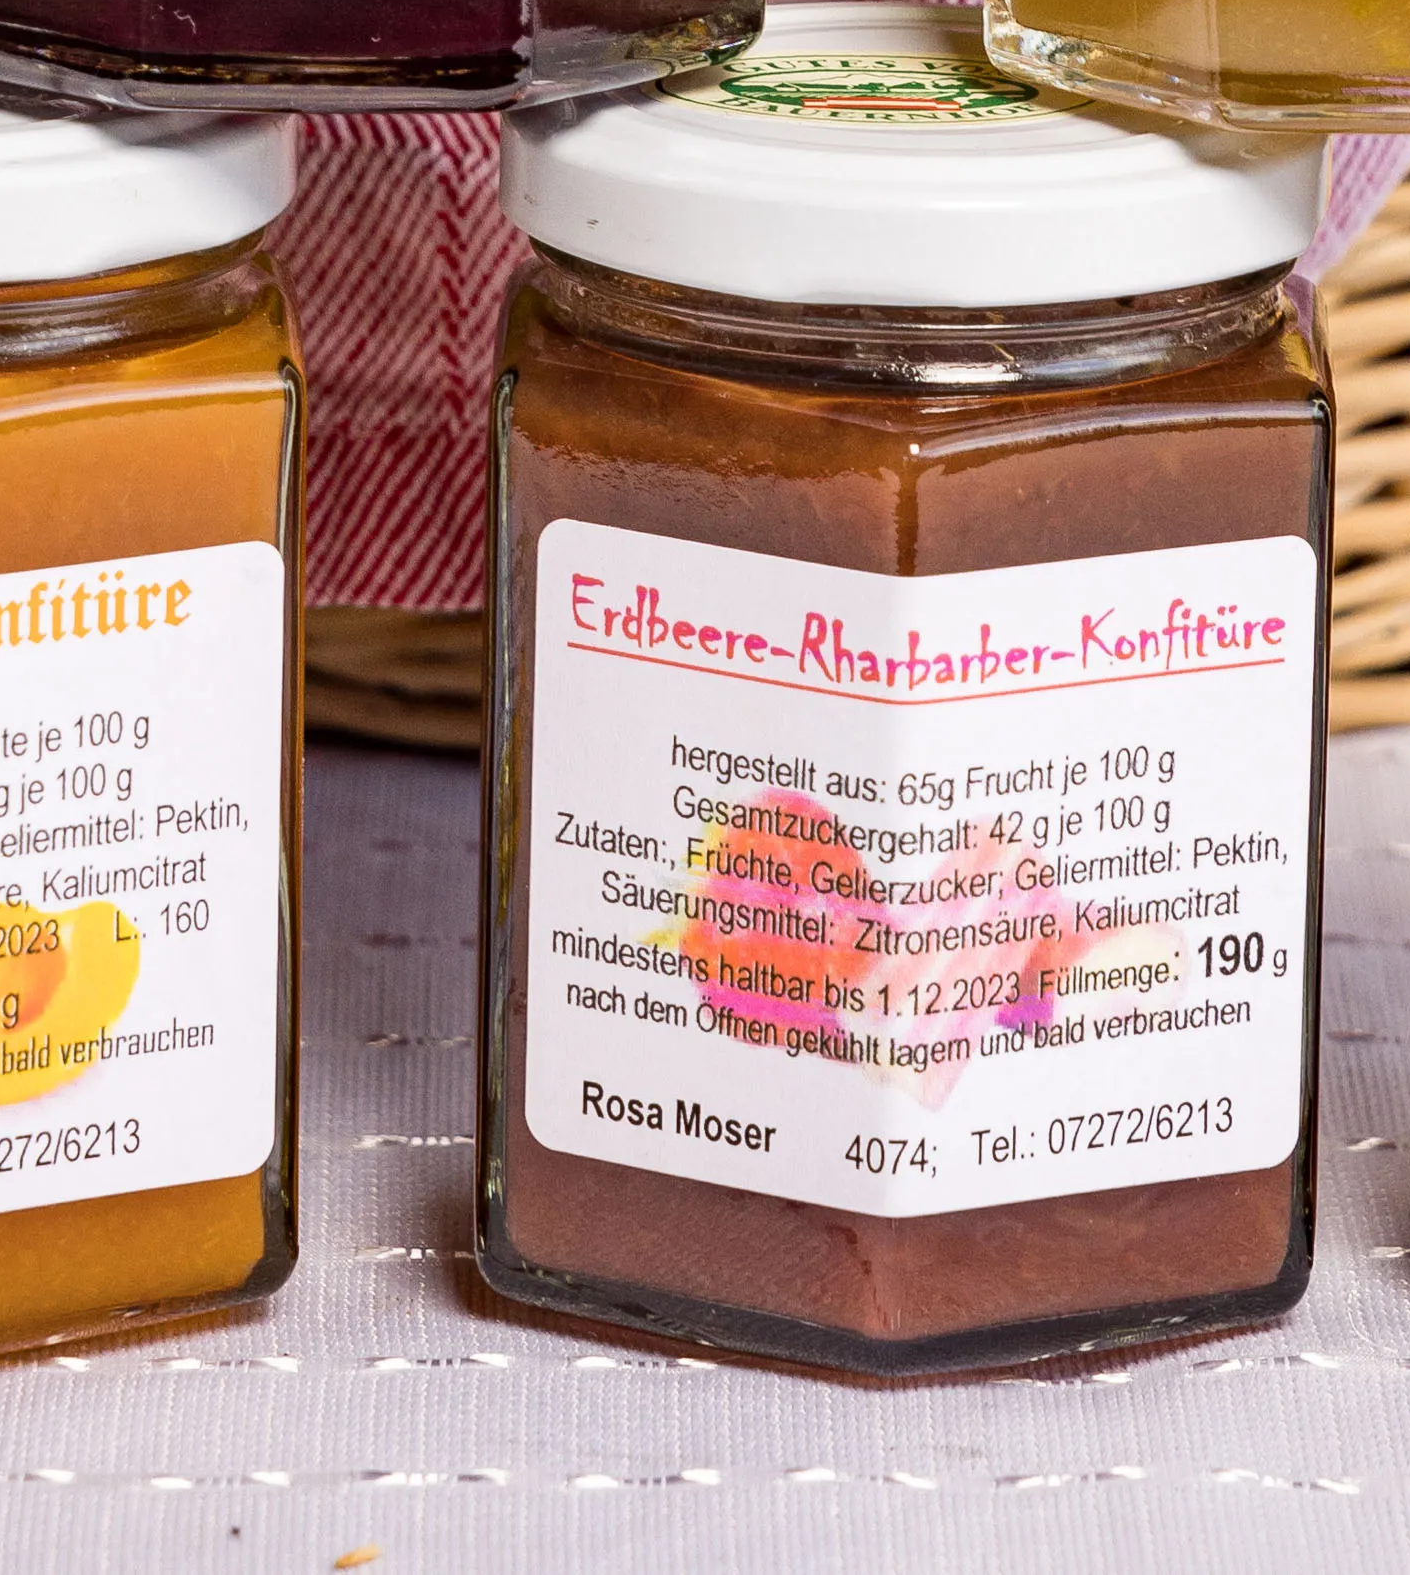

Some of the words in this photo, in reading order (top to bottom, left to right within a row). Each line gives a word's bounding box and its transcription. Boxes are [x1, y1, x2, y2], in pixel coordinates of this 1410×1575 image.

[567, 572, 1288, 690] Erdbeere-Rharbarber-Konfitüre
[35, 720, 62, 763] je
[74, 710, 123, 748] 100
[133, 716, 150, 750] g
[156, 797, 248, 837] Pektin,
[42, 851, 207, 903] Kaliumcitrat
[686, 836, 800, 895] Früchte,
[810, 860, 1004, 906] Gelierzucker;
[1014, 840, 1181, 892] Geliermittel:
[1193, 830, 1288, 870] Pektin,
[160, 898, 210, 936] 160
[601, 869, 834, 946] Säuerungsmittel:
[854, 910, 1062, 956] Zitronensäure,
[1075, 884, 1240, 934] Kaliumcitrat
[552, 926, 710, 984] mindestens
[719, 953, 816, 1004] haltbar
[824, 974, 866, 1013] bis
[877, 970, 1022, 1017] 1.12.2023
[1039, 951, 1180, 1001] Füllmenge:
[1197, 931, 1265, 979] 190
[1272, 948, 1288, 978] g
[2, 992, 20, 1030] g
[581, 1079, 663, 1131] Rosa
[675, 1098, 777, 1153] Moser
[844, 1134, 937, 1178] 4074;
[970, 1125, 1035, 1166] Tel.:
[1048, 1096, 1233, 1155] 07272/6213
